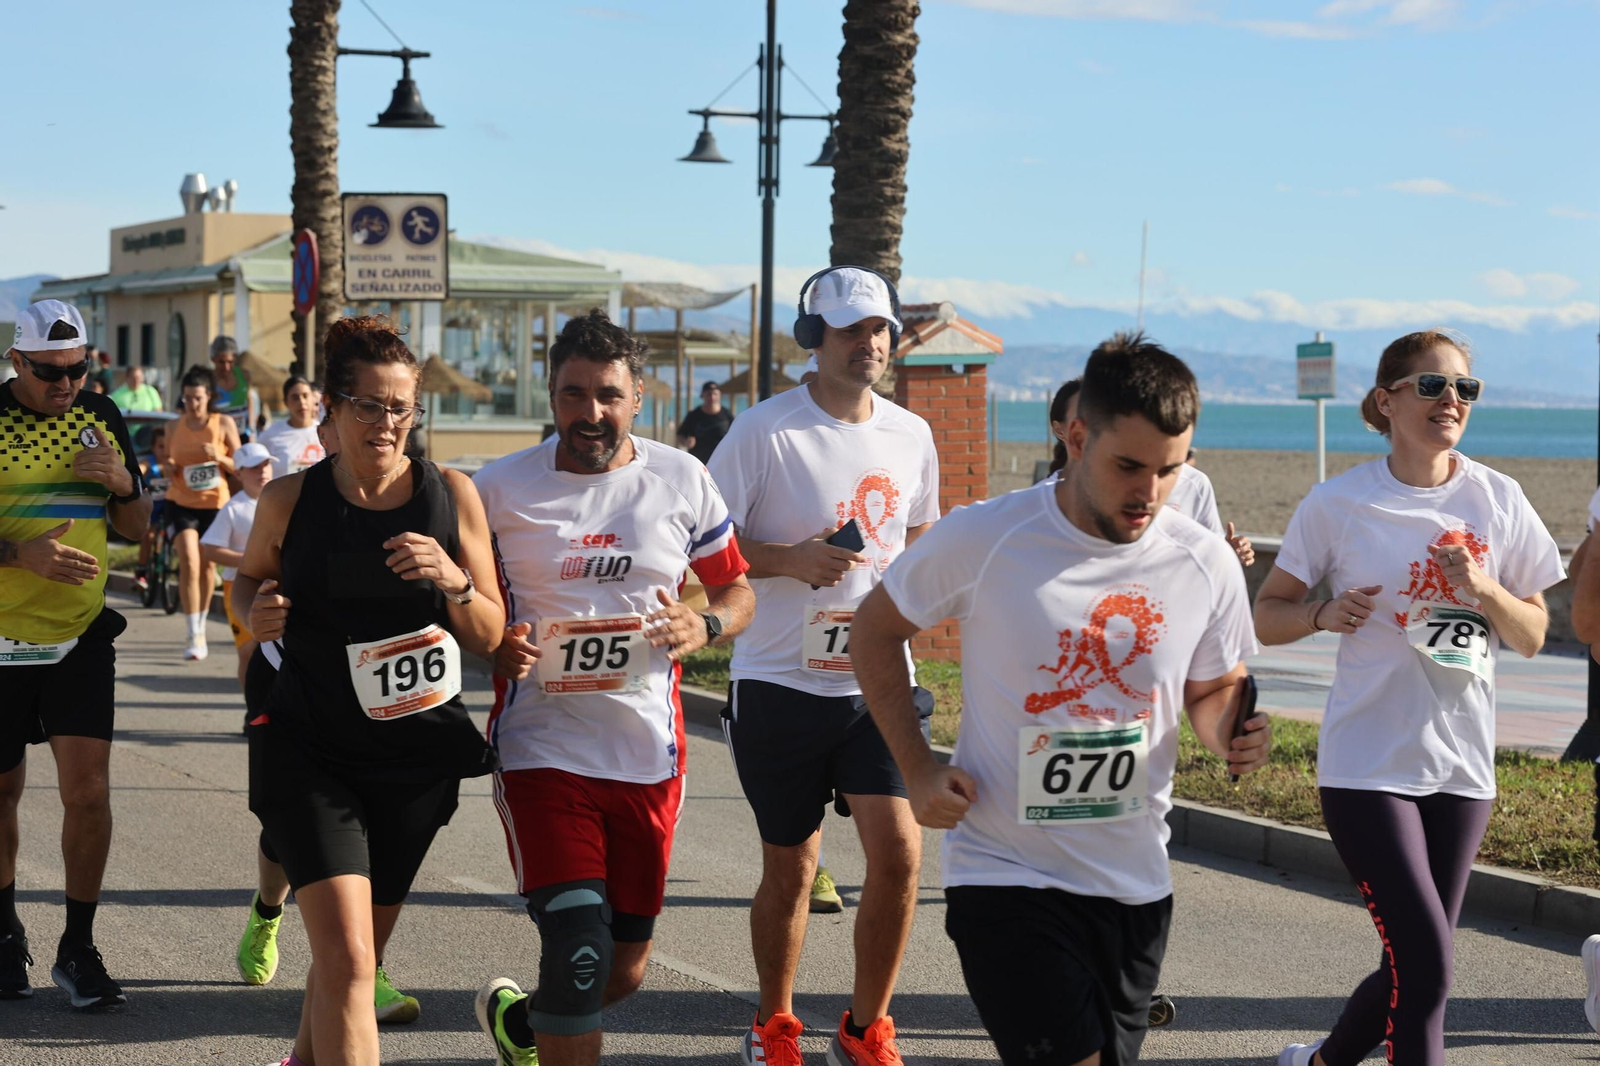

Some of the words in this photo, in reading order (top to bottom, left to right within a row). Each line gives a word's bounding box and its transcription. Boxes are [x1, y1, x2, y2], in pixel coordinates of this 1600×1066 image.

[358, 268, 377, 279] EN
[382, 268, 433, 279] CARRIL
[351, 281, 443, 293] SEÑALIZADO
[189, 469, 216, 484] 693
[559, 635, 631, 672] 195
[373, 647, 446, 697] 196
[1042, 749, 1135, 795] 670
[1027, 808, 1050, 819] 024
